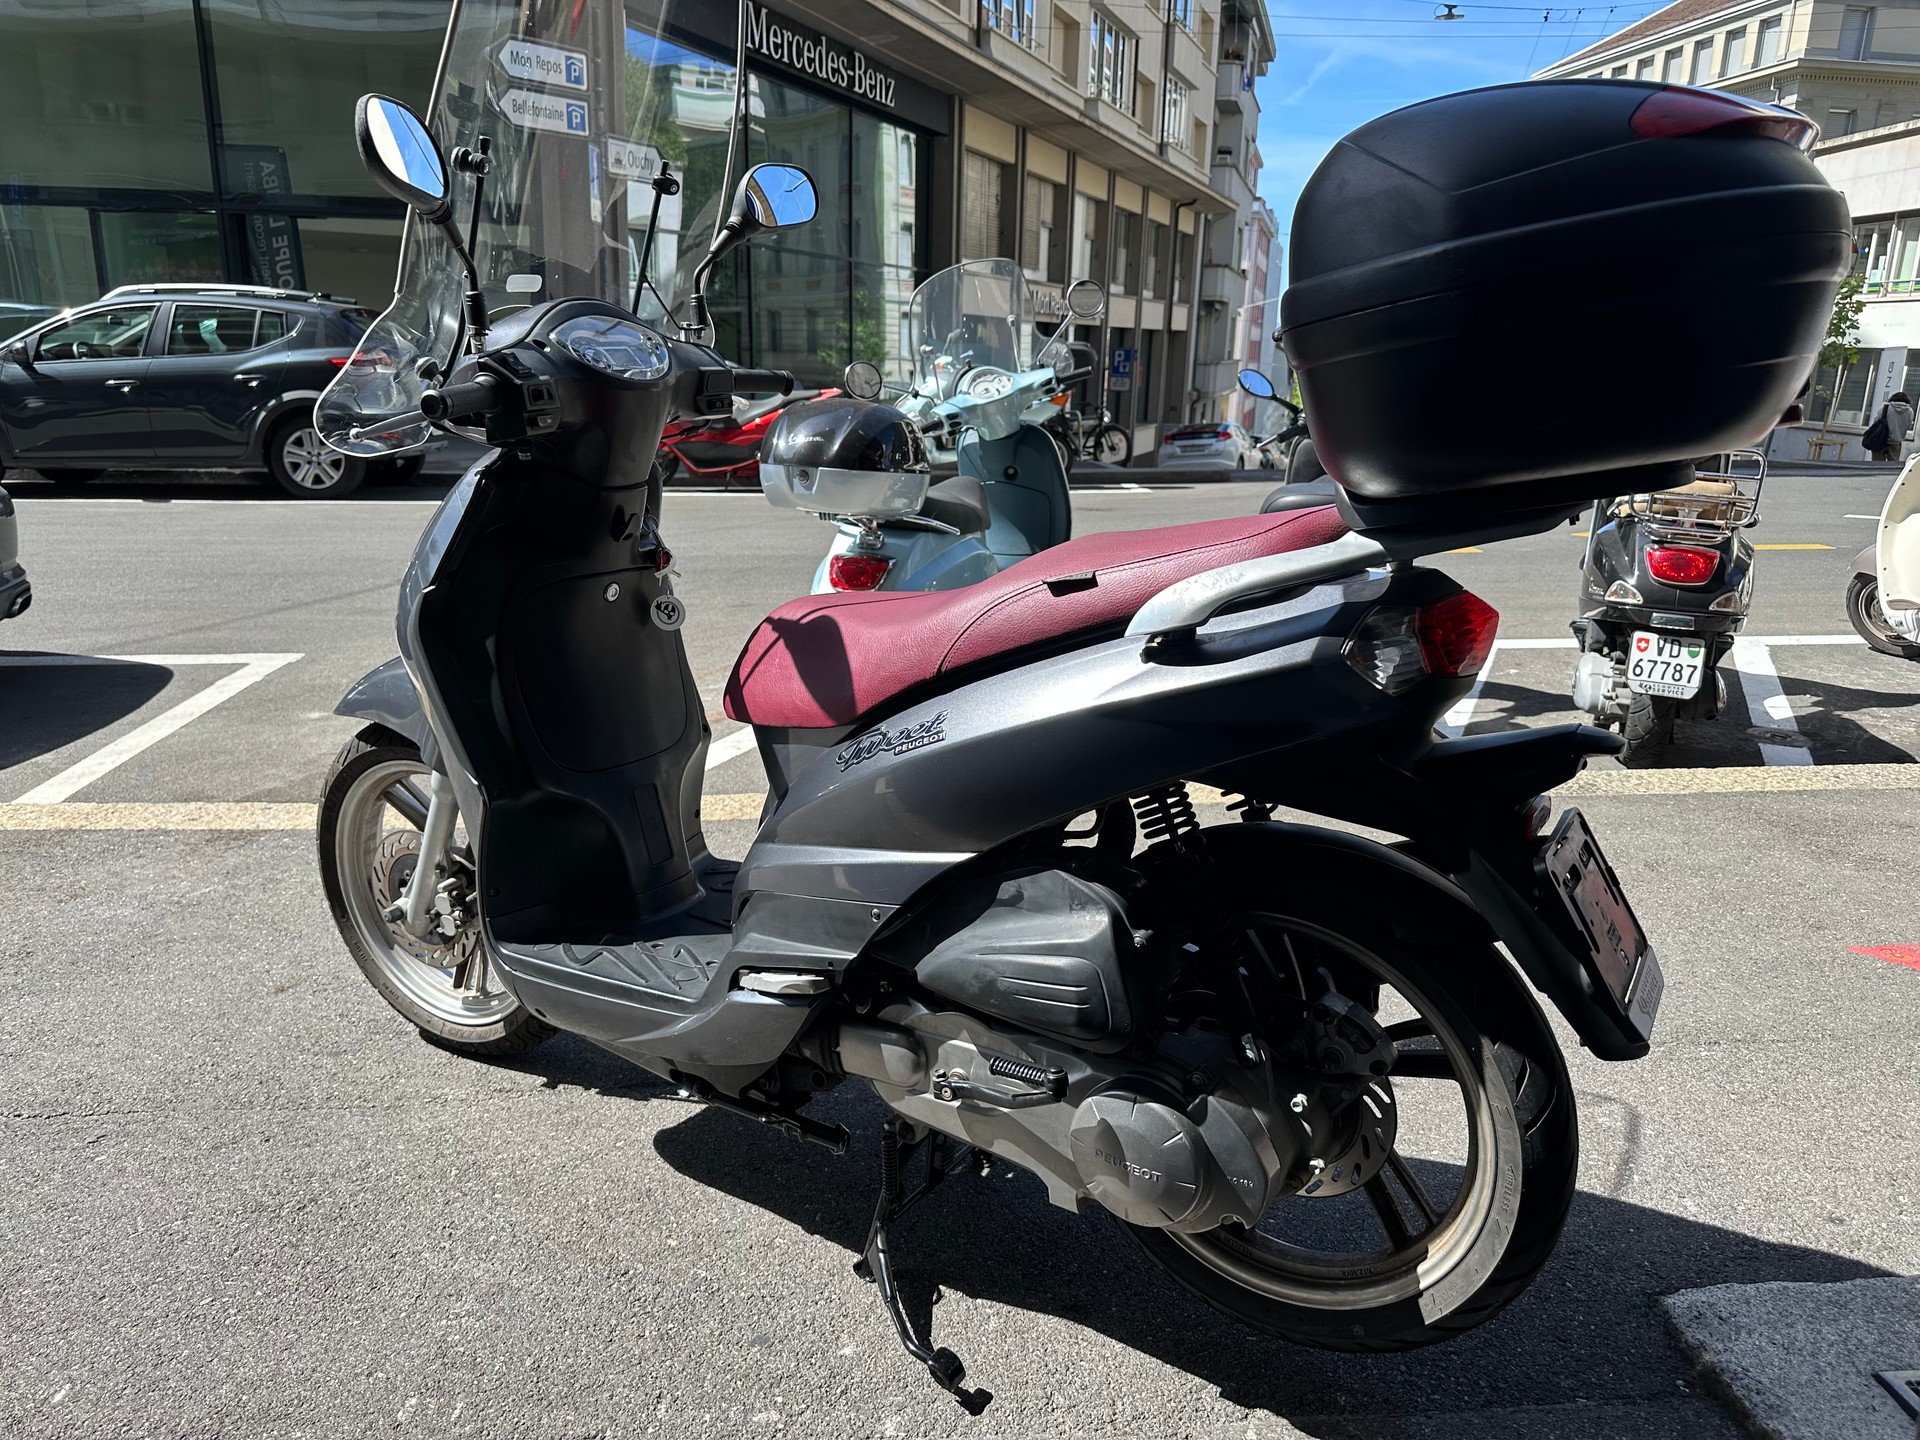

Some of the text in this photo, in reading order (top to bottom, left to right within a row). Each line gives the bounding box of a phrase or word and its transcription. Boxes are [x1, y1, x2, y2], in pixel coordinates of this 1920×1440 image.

[510, 50, 532, 68] Mon
[536, 55, 562, 75] Repos
[746, 1, 896, 107] Mercedes-Benz
[512, 98, 564, 121] Bellefontaine
[627, 150, 655, 175] Ouchy
[1657, 637, 1682, 658] VD
[1632, 658, 1698, 684] 67787
[1652, 687, 1685, 696] SERVICE
[835, 709, 950, 773] Tweet
[895, 730, 947, 755] PEUGEOT
[1094, 1149, 1163, 1183] PEUGEOT
